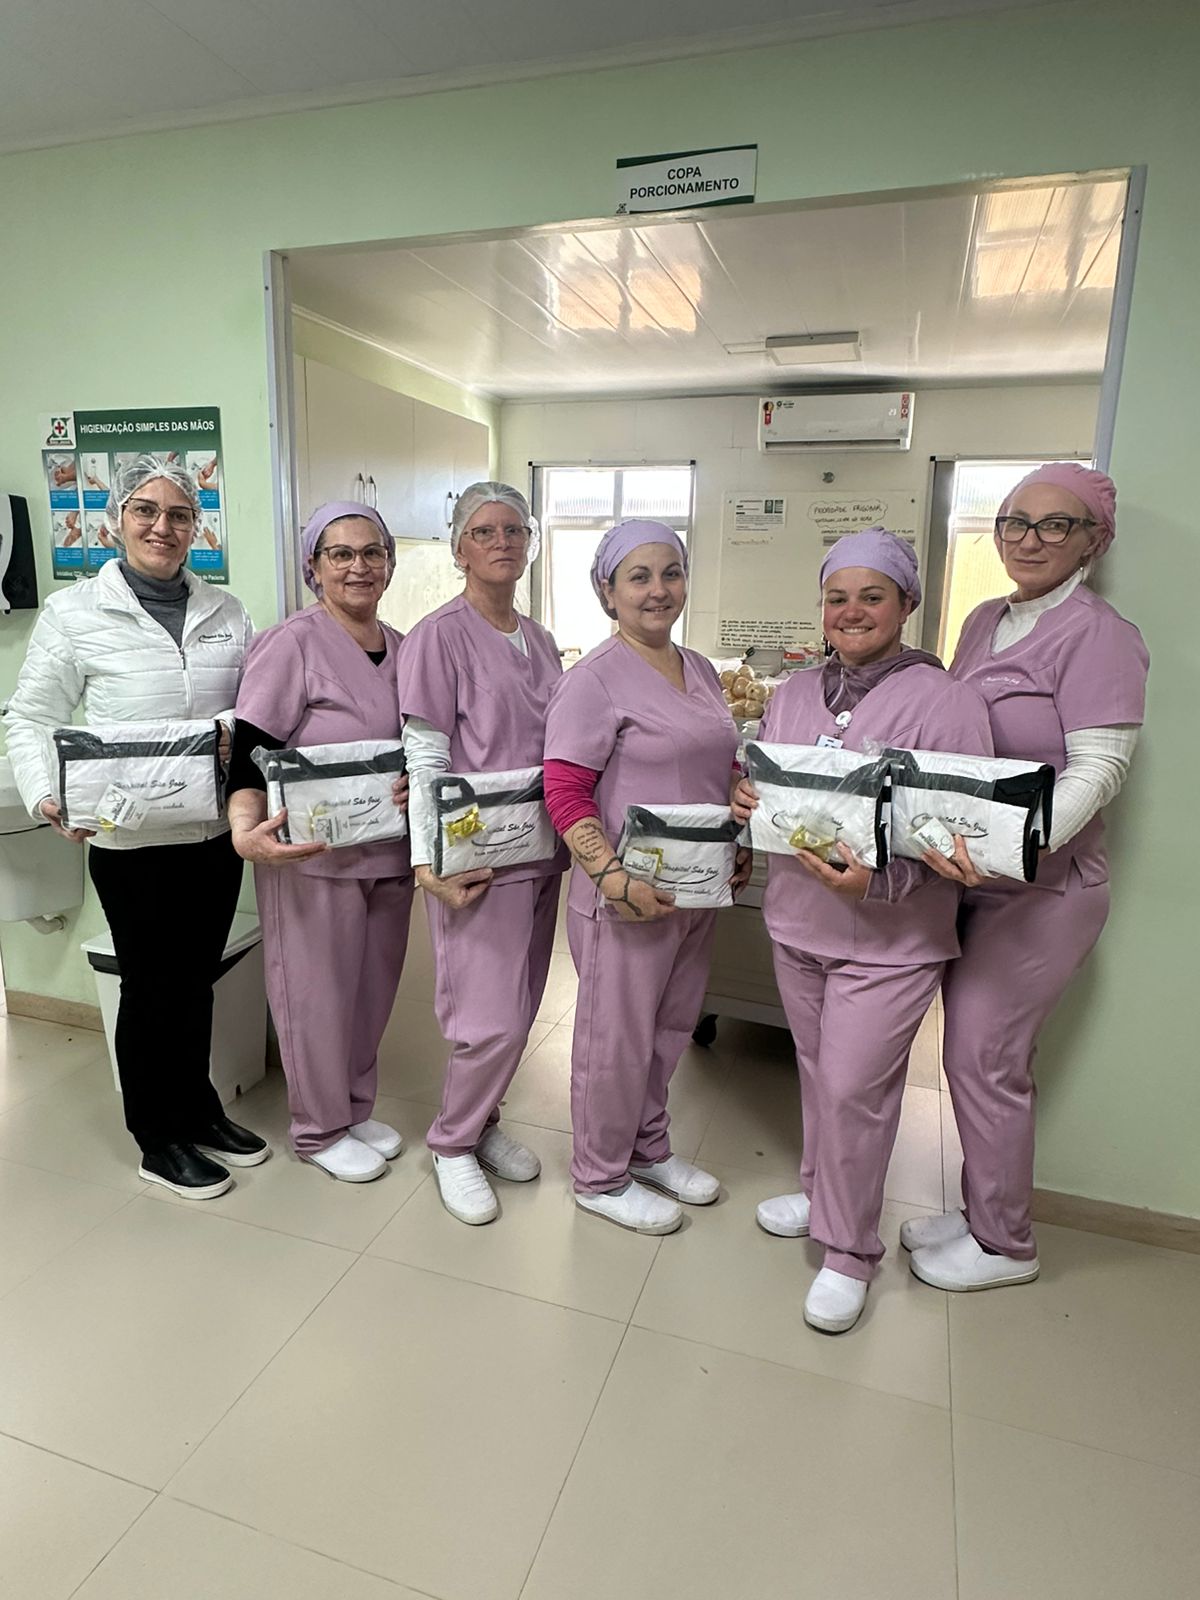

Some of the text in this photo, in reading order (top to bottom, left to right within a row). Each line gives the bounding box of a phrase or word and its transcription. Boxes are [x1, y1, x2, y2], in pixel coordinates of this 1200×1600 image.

[667, 166, 702, 180] COPA
[630, 177, 739, 199] PORCIONAMENTO
[80, 420, 215, 434] HIGIENIZAÇÃO SIMPLES DAS MÃOS
